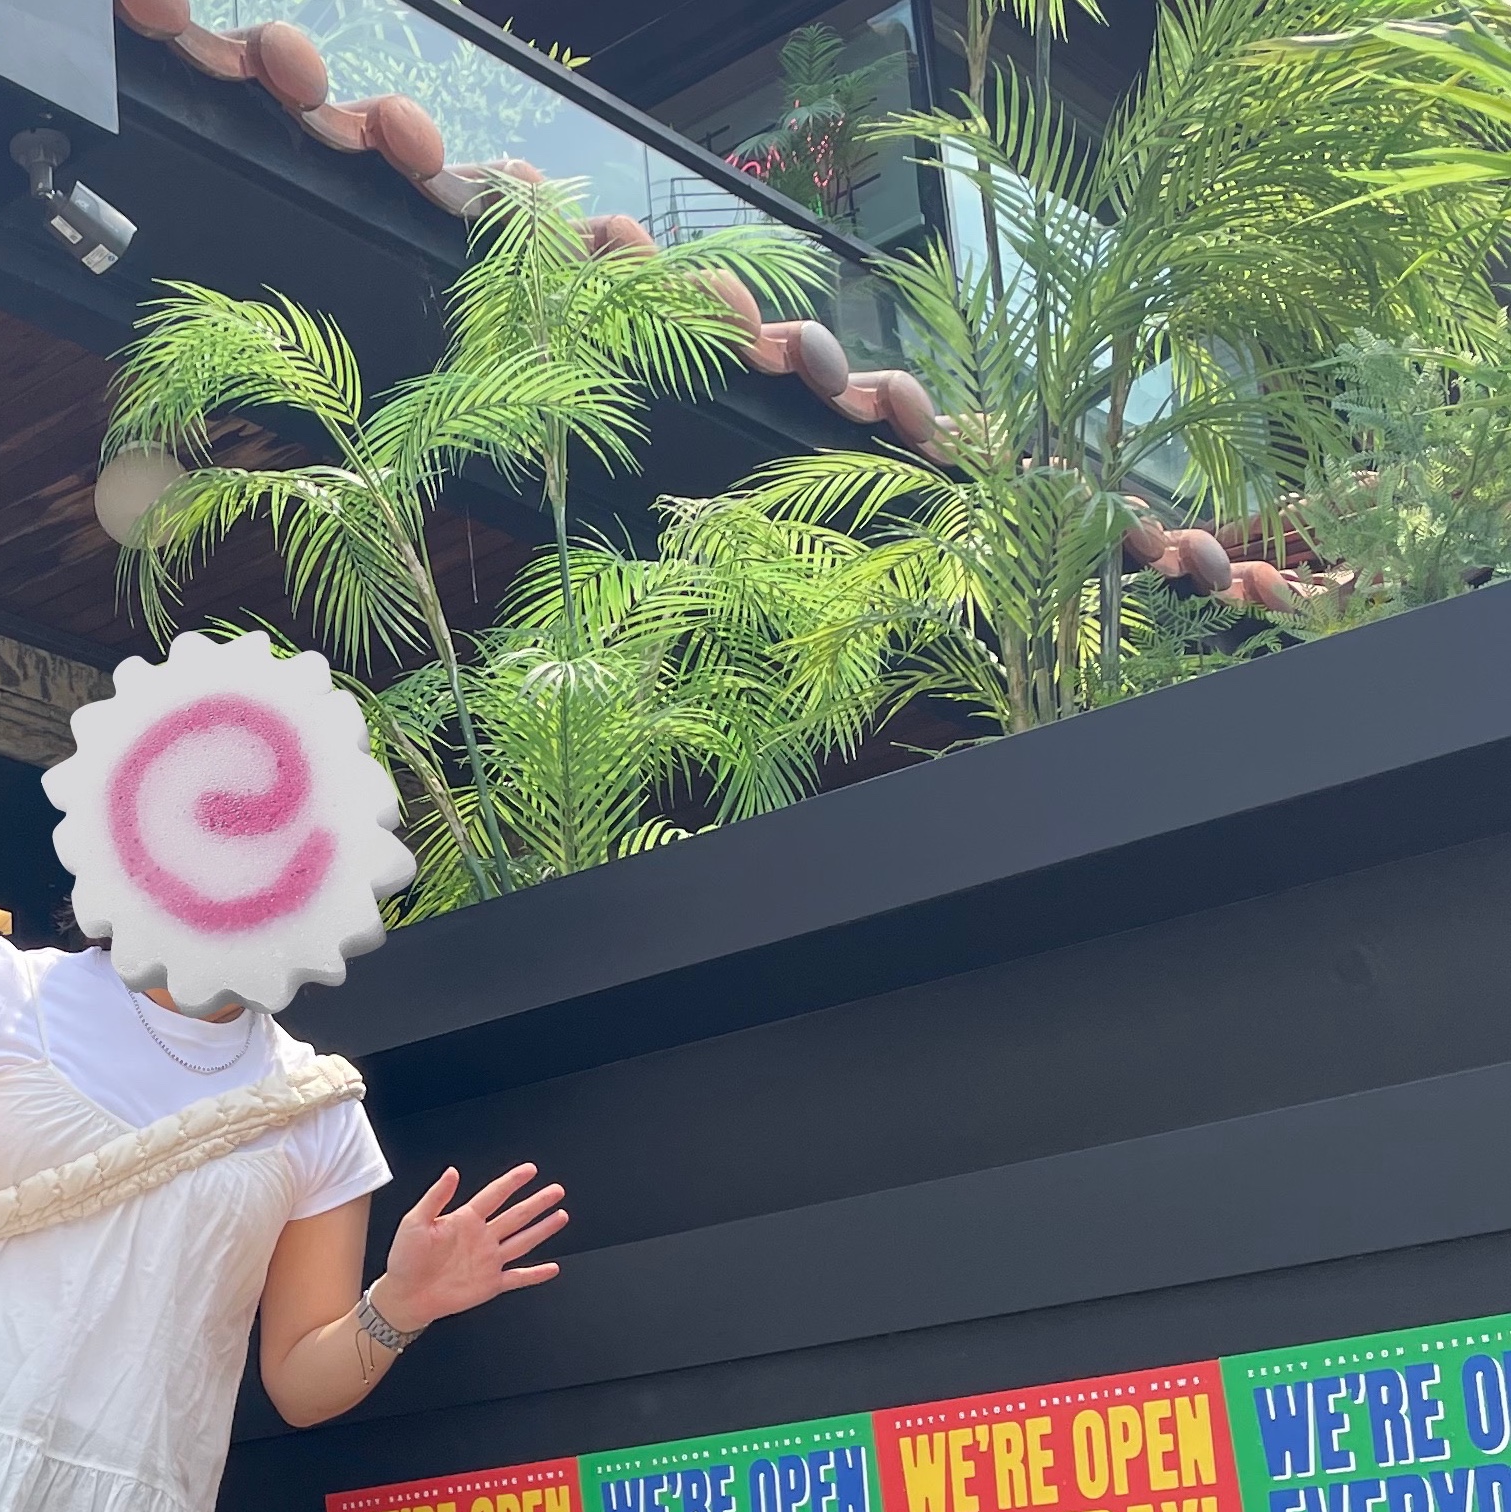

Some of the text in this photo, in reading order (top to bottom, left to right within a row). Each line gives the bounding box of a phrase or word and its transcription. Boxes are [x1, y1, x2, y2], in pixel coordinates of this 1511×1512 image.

[1248, 1347, 1405, 1377] ZESTY SALOON
[895, 1377, 1199, 1428] ZESTY SALOON BREAKING NEWS
[1252, 1362, 1452, 1481] WE'RE
[1074, 1393, 1216, 1500] OPEN
